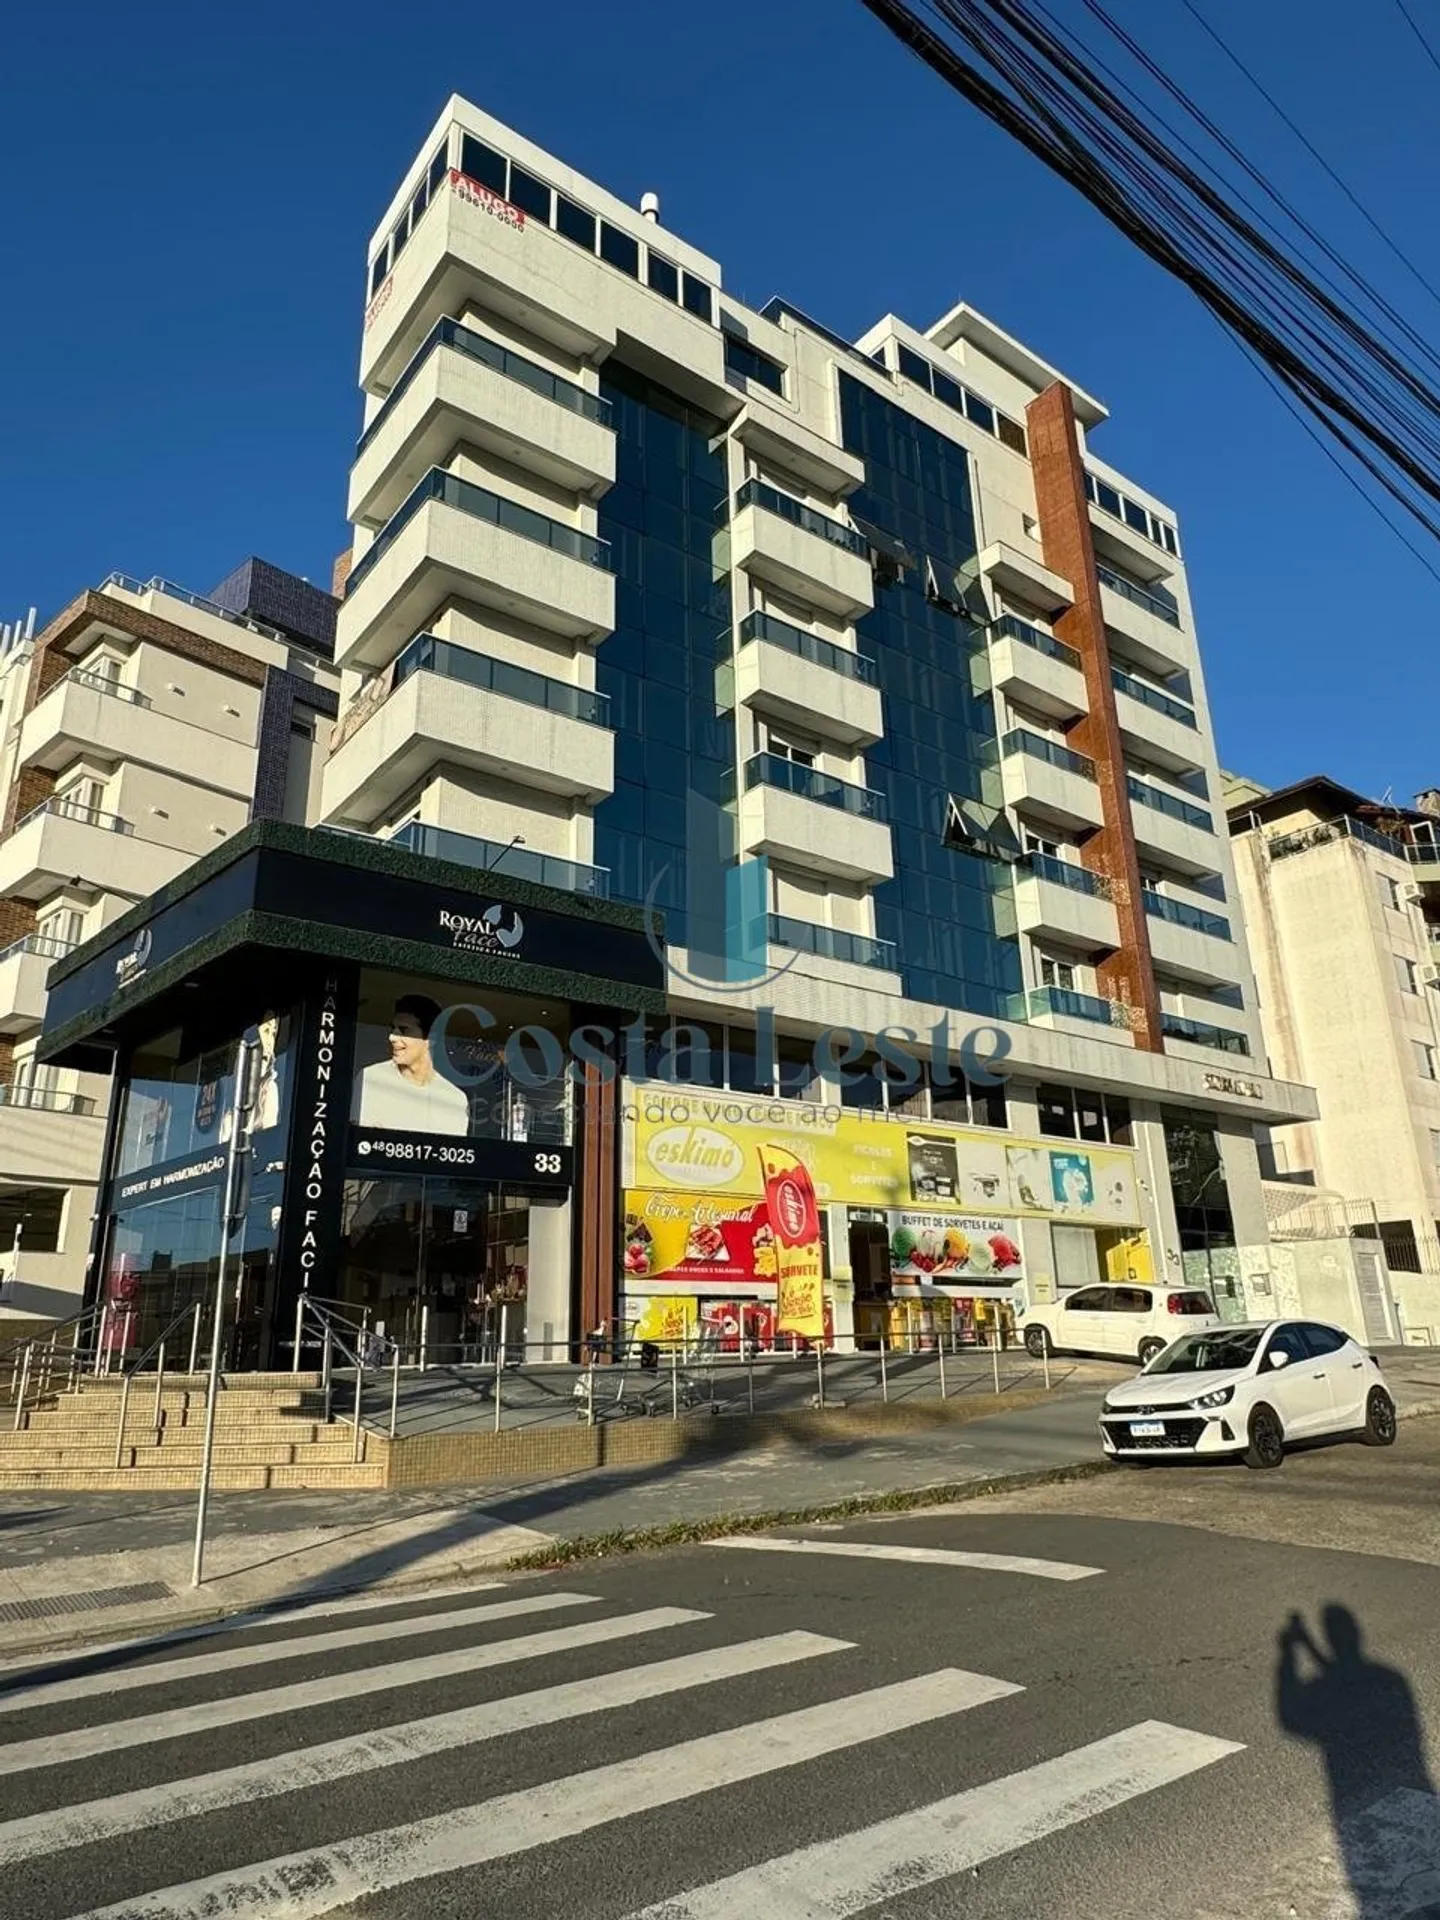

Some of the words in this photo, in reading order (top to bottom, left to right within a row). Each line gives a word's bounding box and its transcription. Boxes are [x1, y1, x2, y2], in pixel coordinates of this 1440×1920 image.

[457, 175, 520, 222] ALUGO
[440, 910, 495, 936] ROYAL
[385, 1142, 476, 1164] 98817-3025
[534, 1153, 562, 1174] 33
[121, 1179, 149, 1198] EXPERT
[150, 1176, 162, 1190] EM
[163, 1155, 226, 1186] HARMONIZAÇÃO
[901, 1215, 932, 1227] BUFFET
[934, 1218, 944, 1227] DE
[300, 1210, 318, 1308] FACI
[780, 1264, 818, 1279] SORVETE
